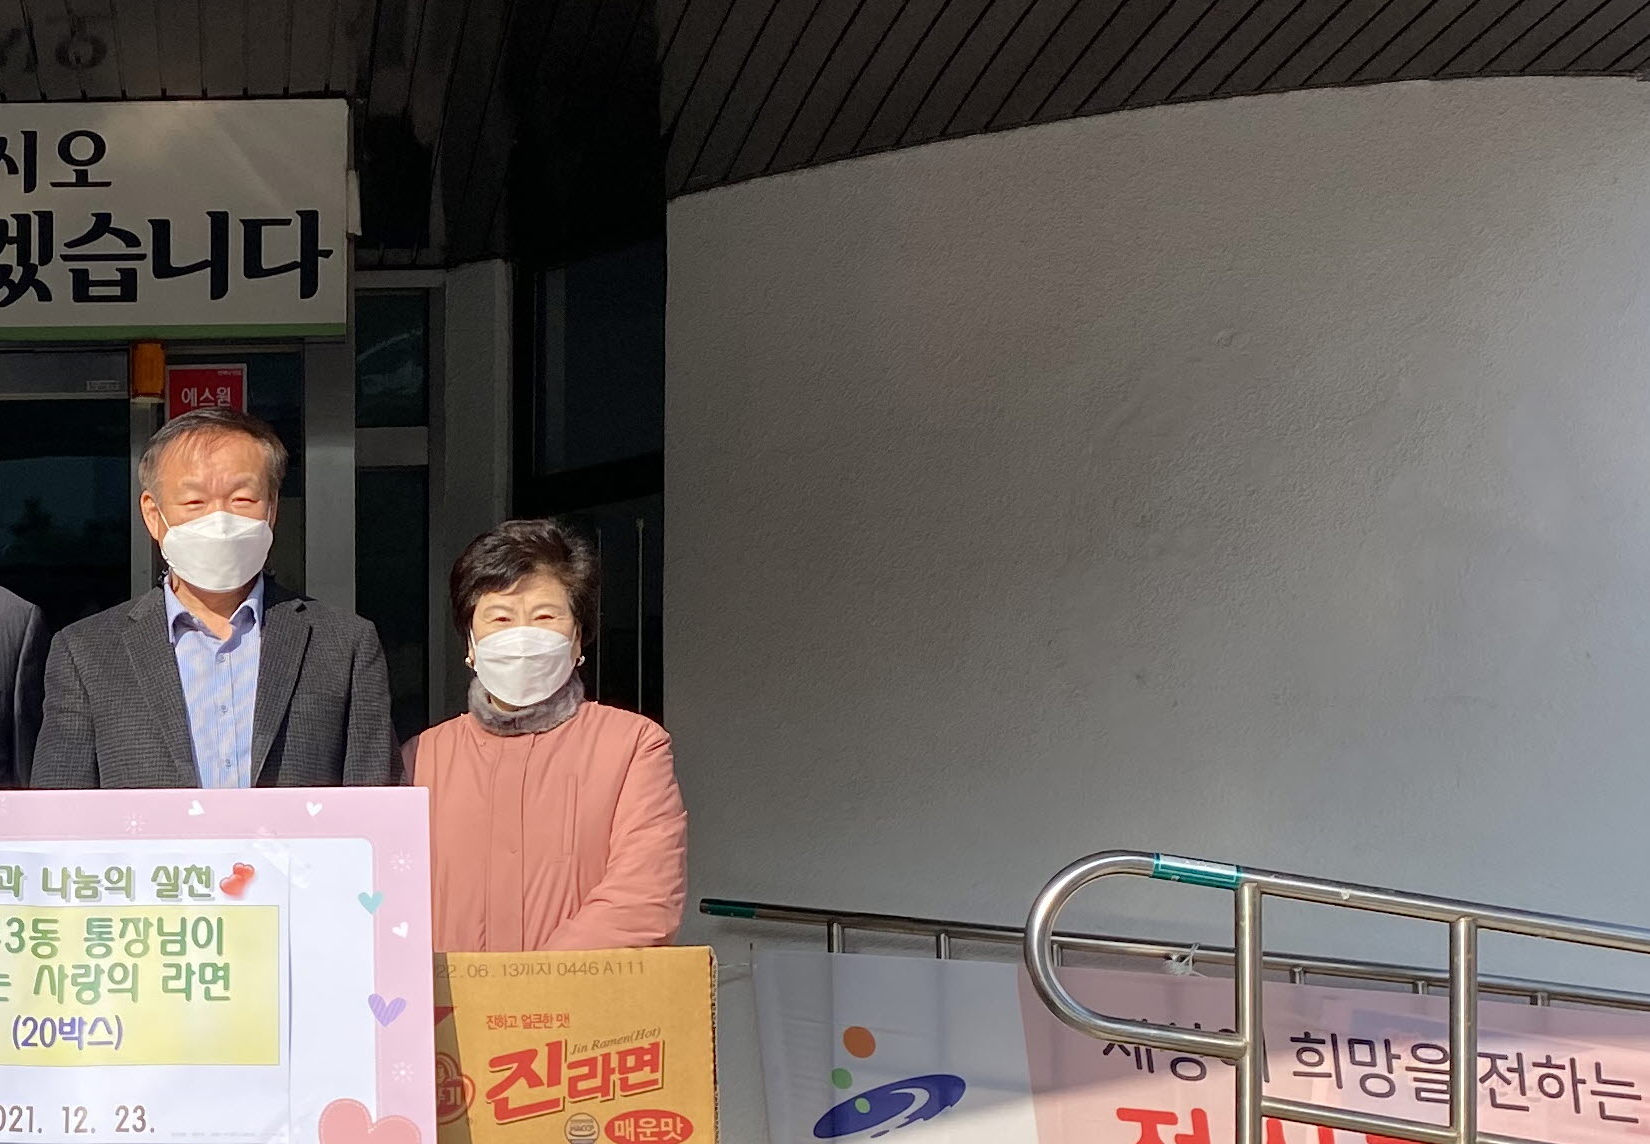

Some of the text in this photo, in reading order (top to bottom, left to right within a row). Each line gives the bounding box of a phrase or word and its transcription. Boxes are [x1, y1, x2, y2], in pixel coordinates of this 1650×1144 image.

[181, 386, 231, 407] 에스원
[42, 865, 135, 900] 나눔의
[151, 864, 216, 901] 실천
[84, 916, 225, 960] 통장님이
[34, 962, 139, 1001] 사랑의
[161, 962, 231, 1001] 라면
[12, 1014, 122, 1051] (20박스)
[486, 1014, 518, 1030] 진하고
[521, 1014, 553, 1030] 얼큰한
[571, 1043, 588, 1055] Jin
[486, 1039, 665, 1124] 진라면
[1290, 1032, 1450, 1104] 희망을
[1477, 1052, 1642, 1124] 전하는
[62, 1106, 96, 1134] 12.
[115, 1105, 155, 1134] 23.
[614, 1117, 684, 1142] 매운맛
